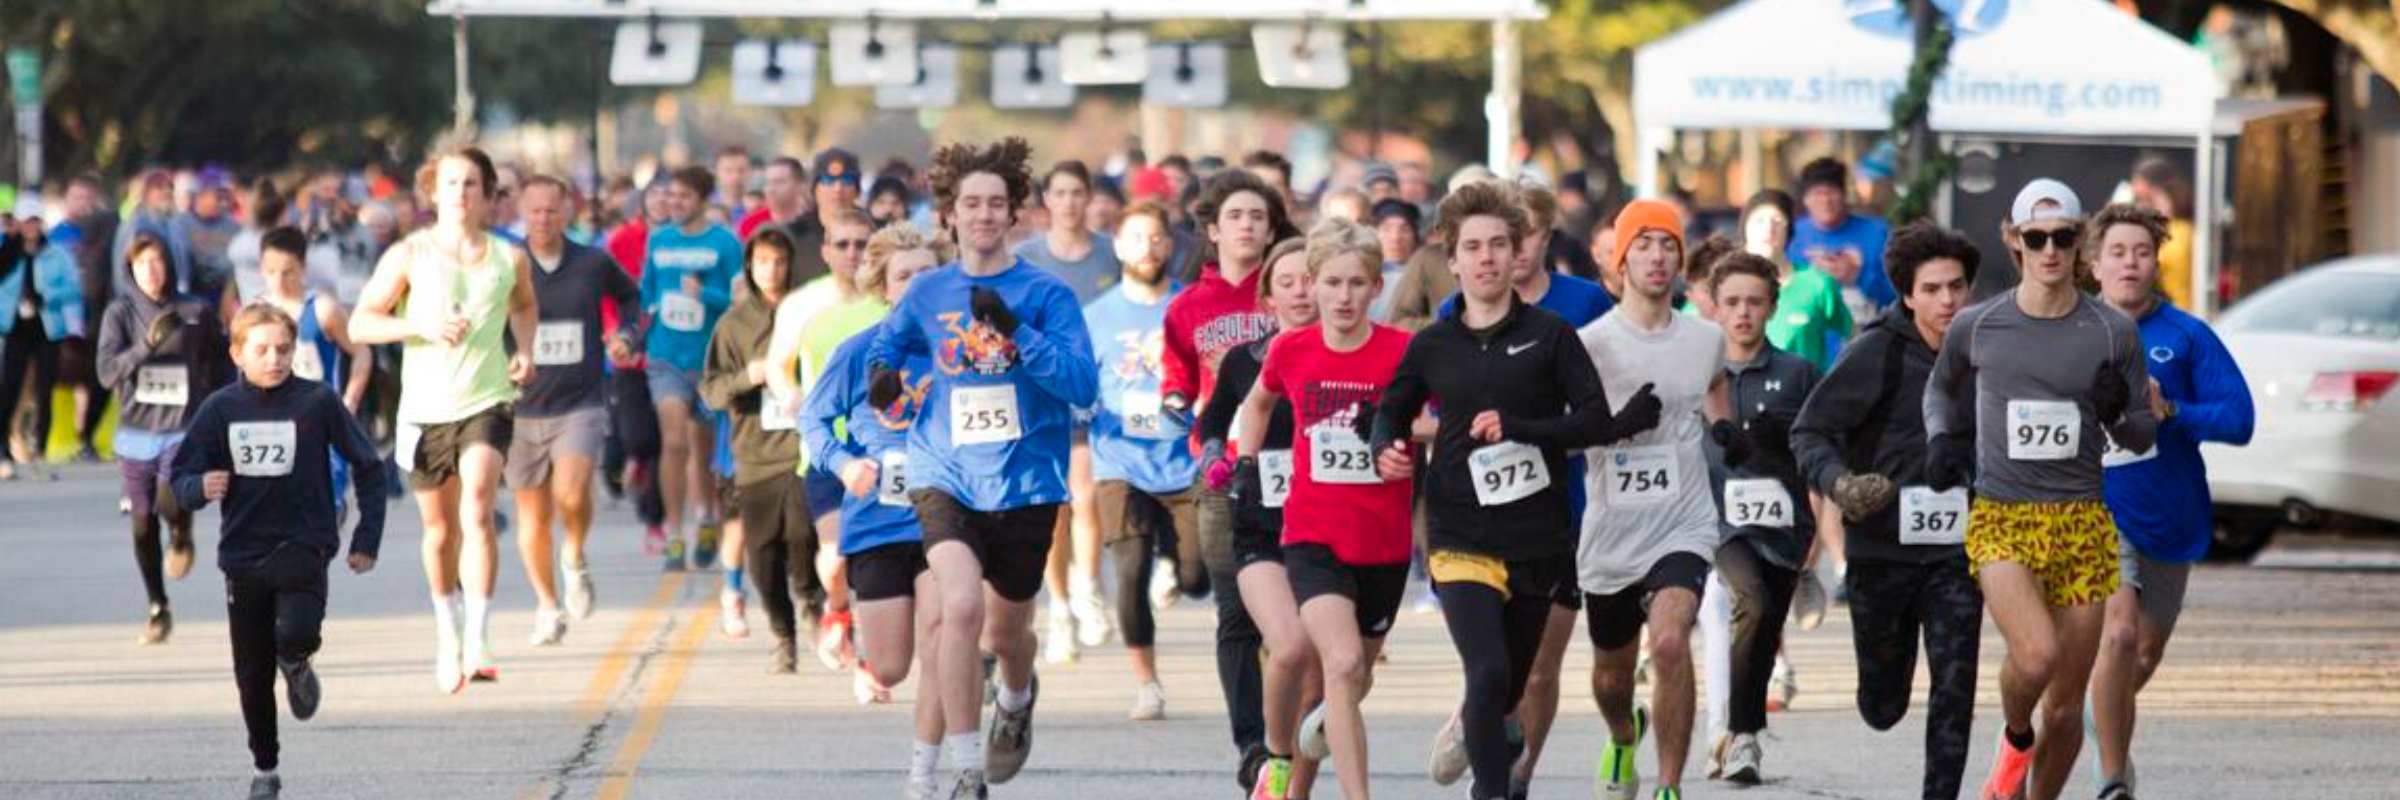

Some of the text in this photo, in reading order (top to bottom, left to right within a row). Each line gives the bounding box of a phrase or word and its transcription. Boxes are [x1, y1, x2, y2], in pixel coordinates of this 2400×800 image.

[1691, 68, 2161, 119] www.simptiming.com
[1193, 312, 1278, 353] CAROLIN
[961, 409, 1009, 431] 255
[2018, 424, 2069, 446] 976
[240, 444, 286, 464] 372
[1321, 449, 1371, 470] 923
[891, 475, 906, 494] 5
[1484, 460, 1538, 492] 972
[1617, 468, 1669, 492] 754
[1736, 500, 1783, 521] 374
[1911, 510, 1959, 532] 367
